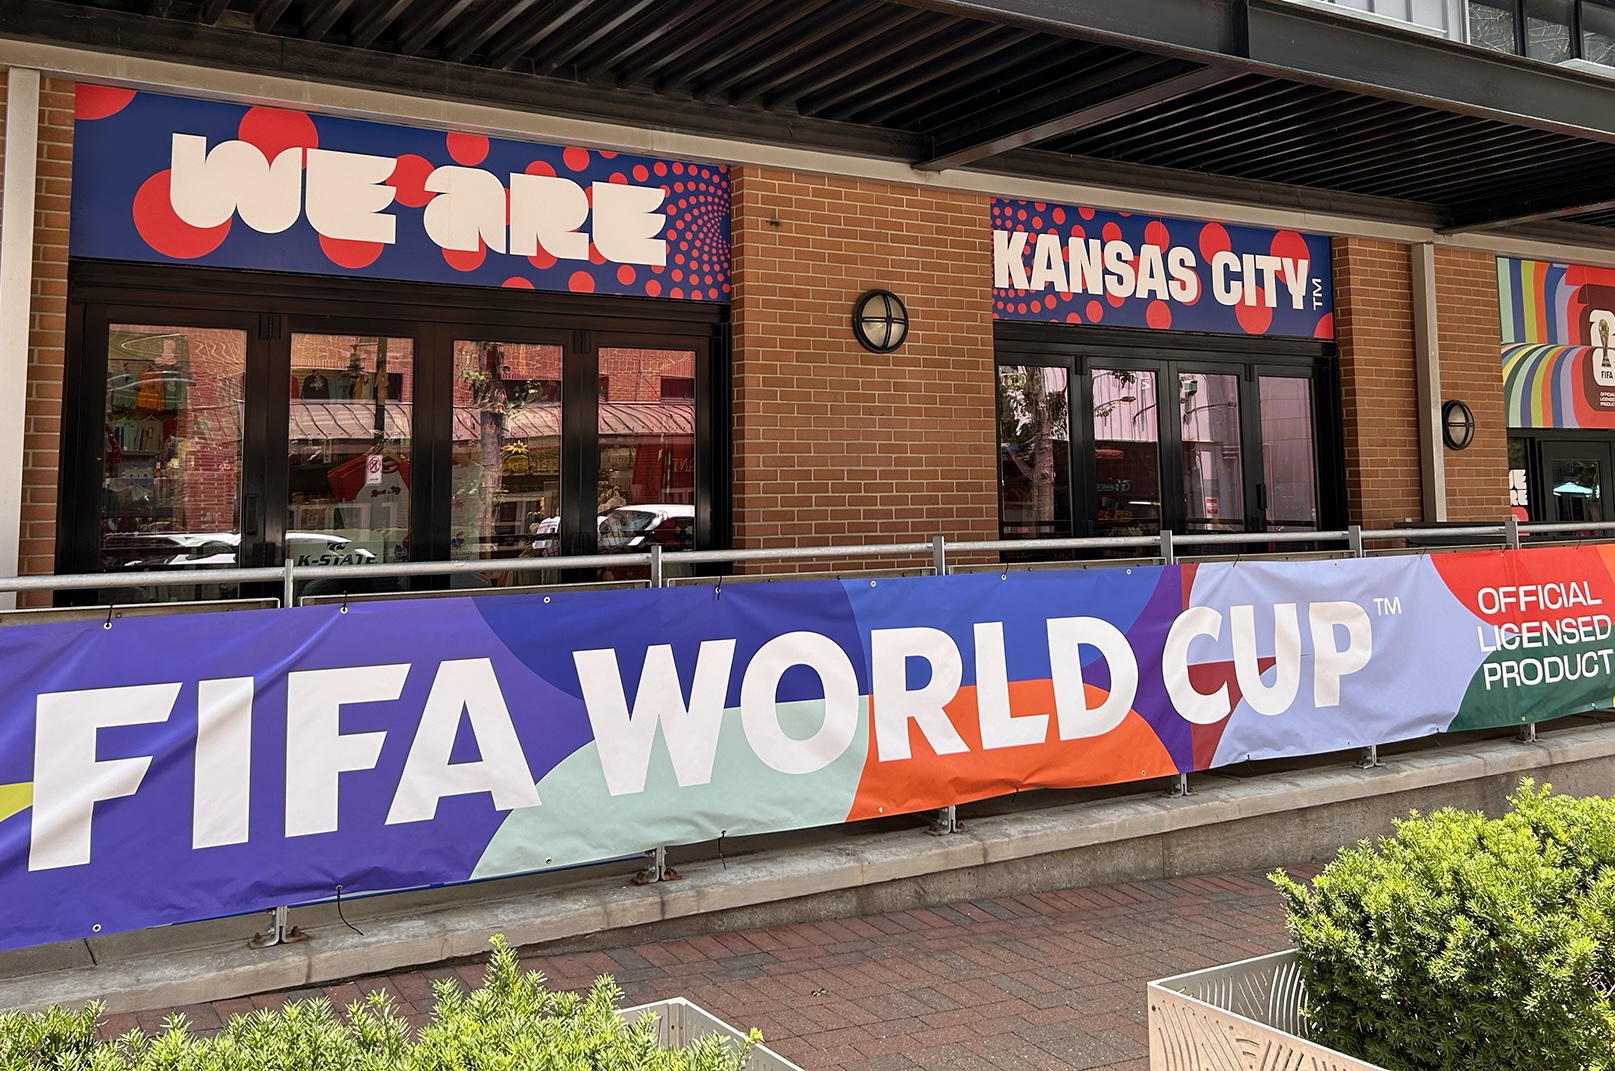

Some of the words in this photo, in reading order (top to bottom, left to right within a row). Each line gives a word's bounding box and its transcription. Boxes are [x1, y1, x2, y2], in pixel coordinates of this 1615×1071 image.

[170, 133, 397, 244] WE
[423, 165, 667, 266] ARE
[993, 230, 1198, 302] KANSAS
[1212, 251, 1309, 310] CITY
[1601, 370, 1614, 379] FIFA
[297, 553, 378, 567] K-STATE
[1477, 580, 1602, 615] OFFICIAL
[1477, 614, 1611, 653] LICENSED
[1483, 648, 1614, 691] PRODUCT
[28, 657, 542, 872] FIFA
[572, 616, 1139, 796] WORLD
[1161, 601, 1373, 725] CUP
[1373, 596, 1402, 616] TM
